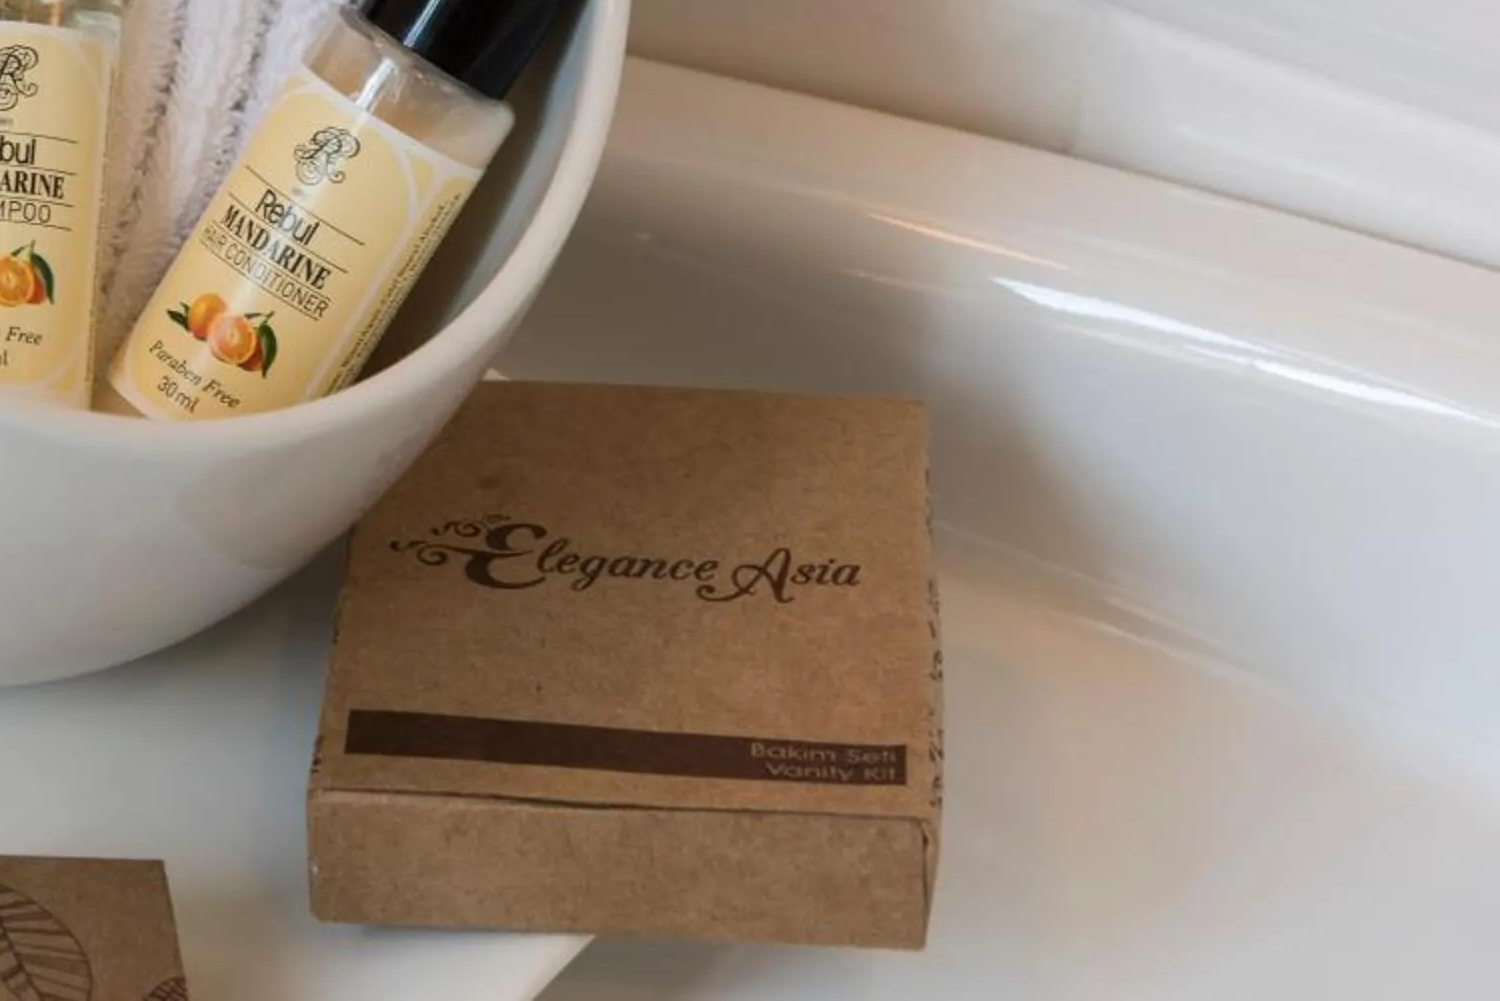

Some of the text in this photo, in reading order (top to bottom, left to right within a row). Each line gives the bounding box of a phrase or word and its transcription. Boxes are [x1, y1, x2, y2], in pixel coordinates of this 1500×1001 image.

[221, 204, 332, 291] MANDARINE
[255, 189, 322, 246] Rebul
[225, 242, 330, 318] CONDITIONER
[6, 326, 43, 346] Free
[148, 339, 241, 409] Paraben Free
[392, 514, 862, 604] Elegance Asia
[764, 762, 897, 782] Vanity Kit
[847, 748, 897, 764] Seti
